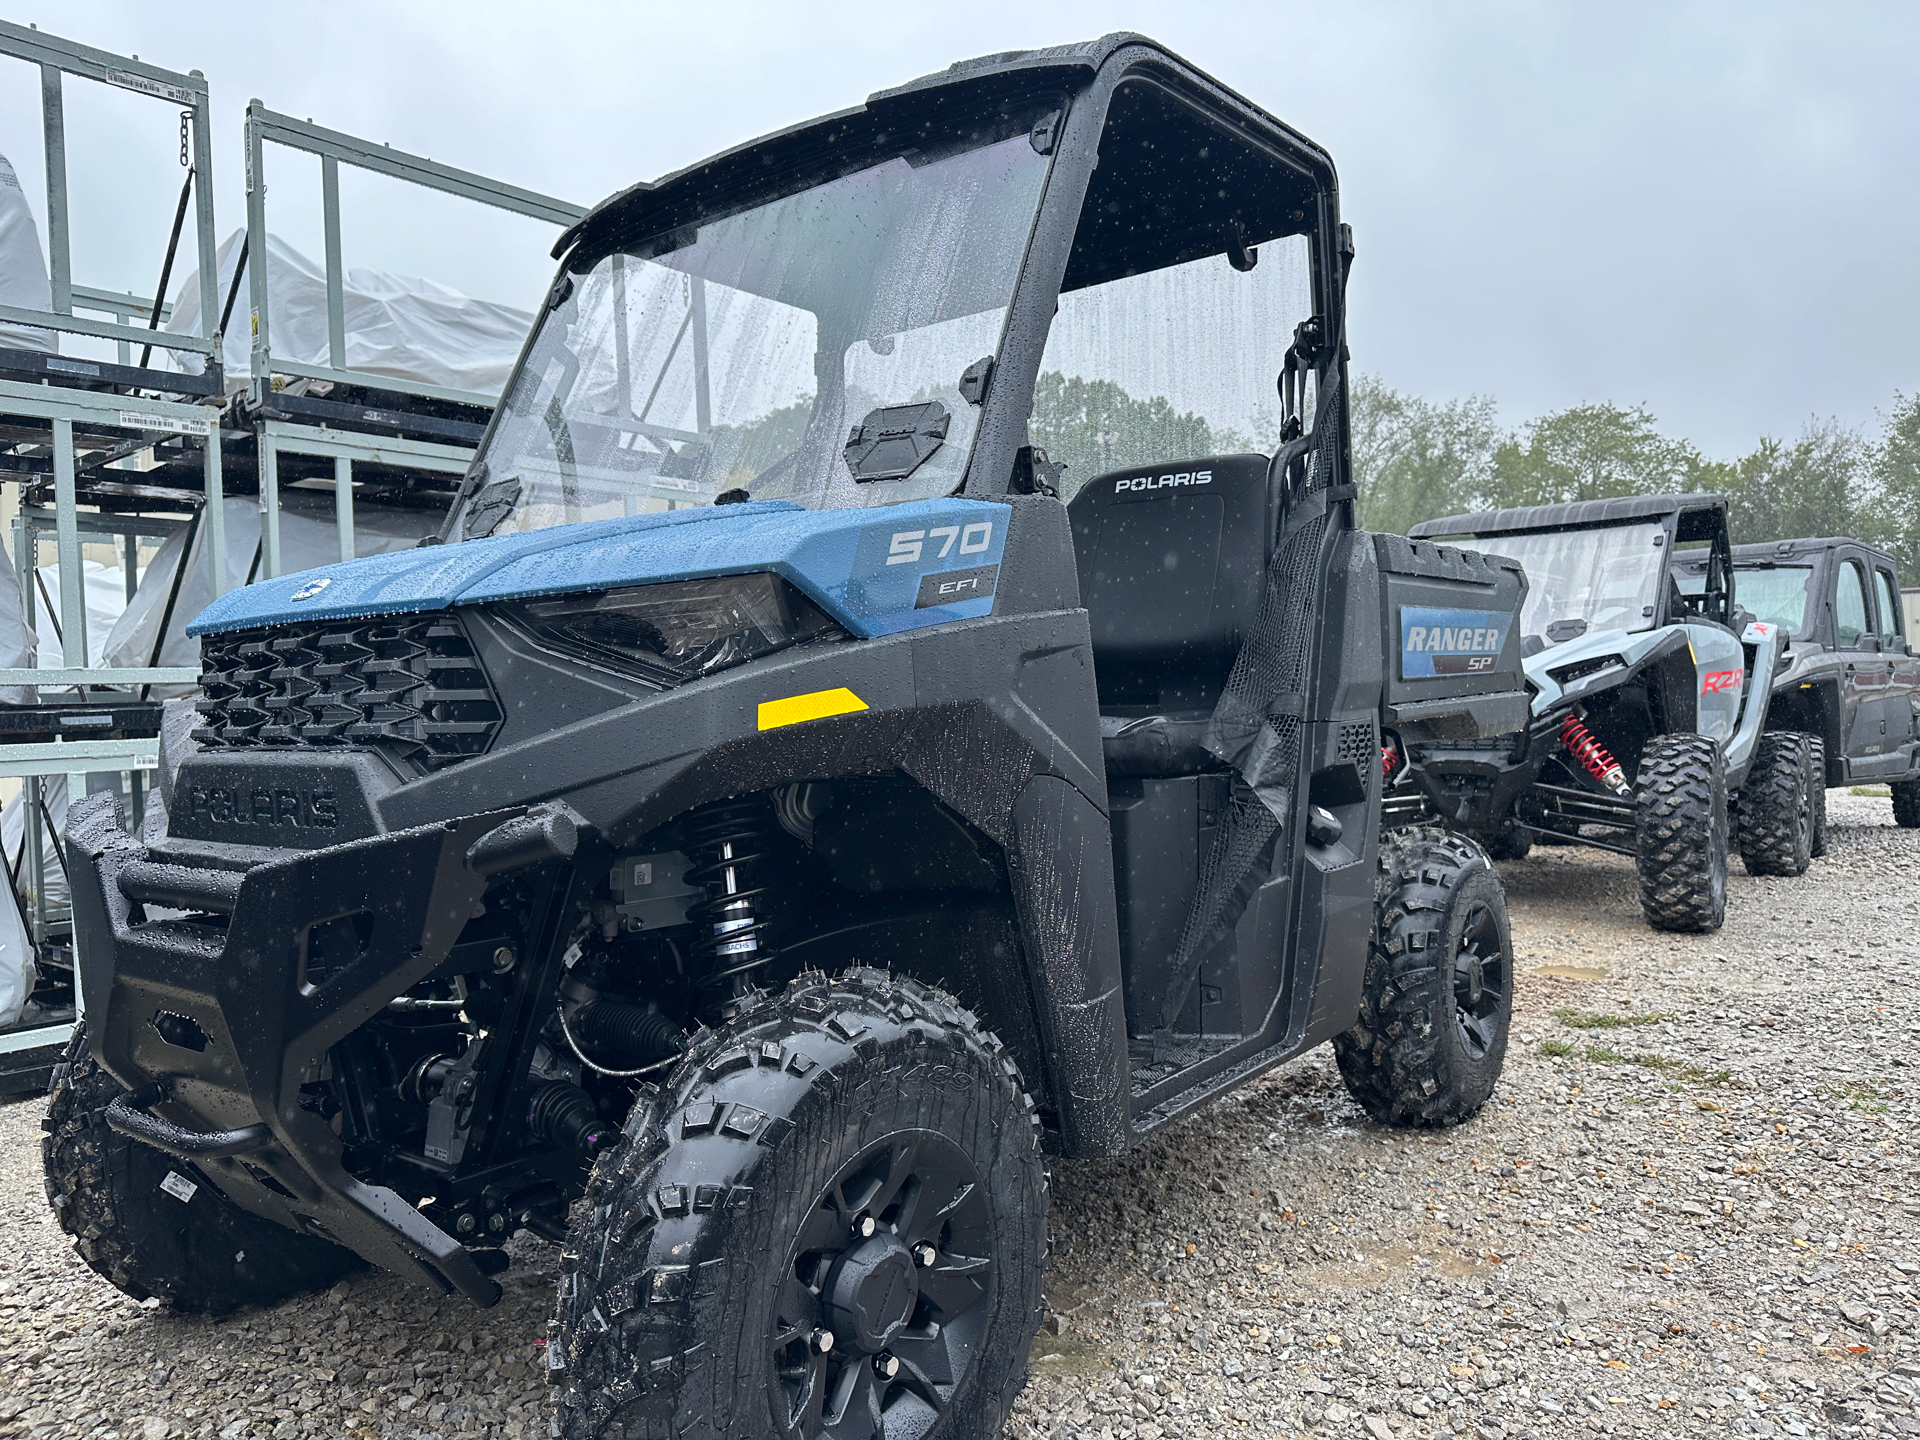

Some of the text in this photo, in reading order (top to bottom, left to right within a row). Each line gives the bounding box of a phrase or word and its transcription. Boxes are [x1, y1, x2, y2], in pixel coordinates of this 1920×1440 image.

[1115, 471, 1212, 493] POLARIS
[886, 522, 993, 566] 570
[939, 579, 977, 594] EFI
[1406, 626, 1499, 652] RANGER
[1467, 657, 1492, 670] SP
[1701, 668, 1743, 697] RZR
[189, 786, 340, 829] POLARIS
[725, 942, 749, 951] SACHS
